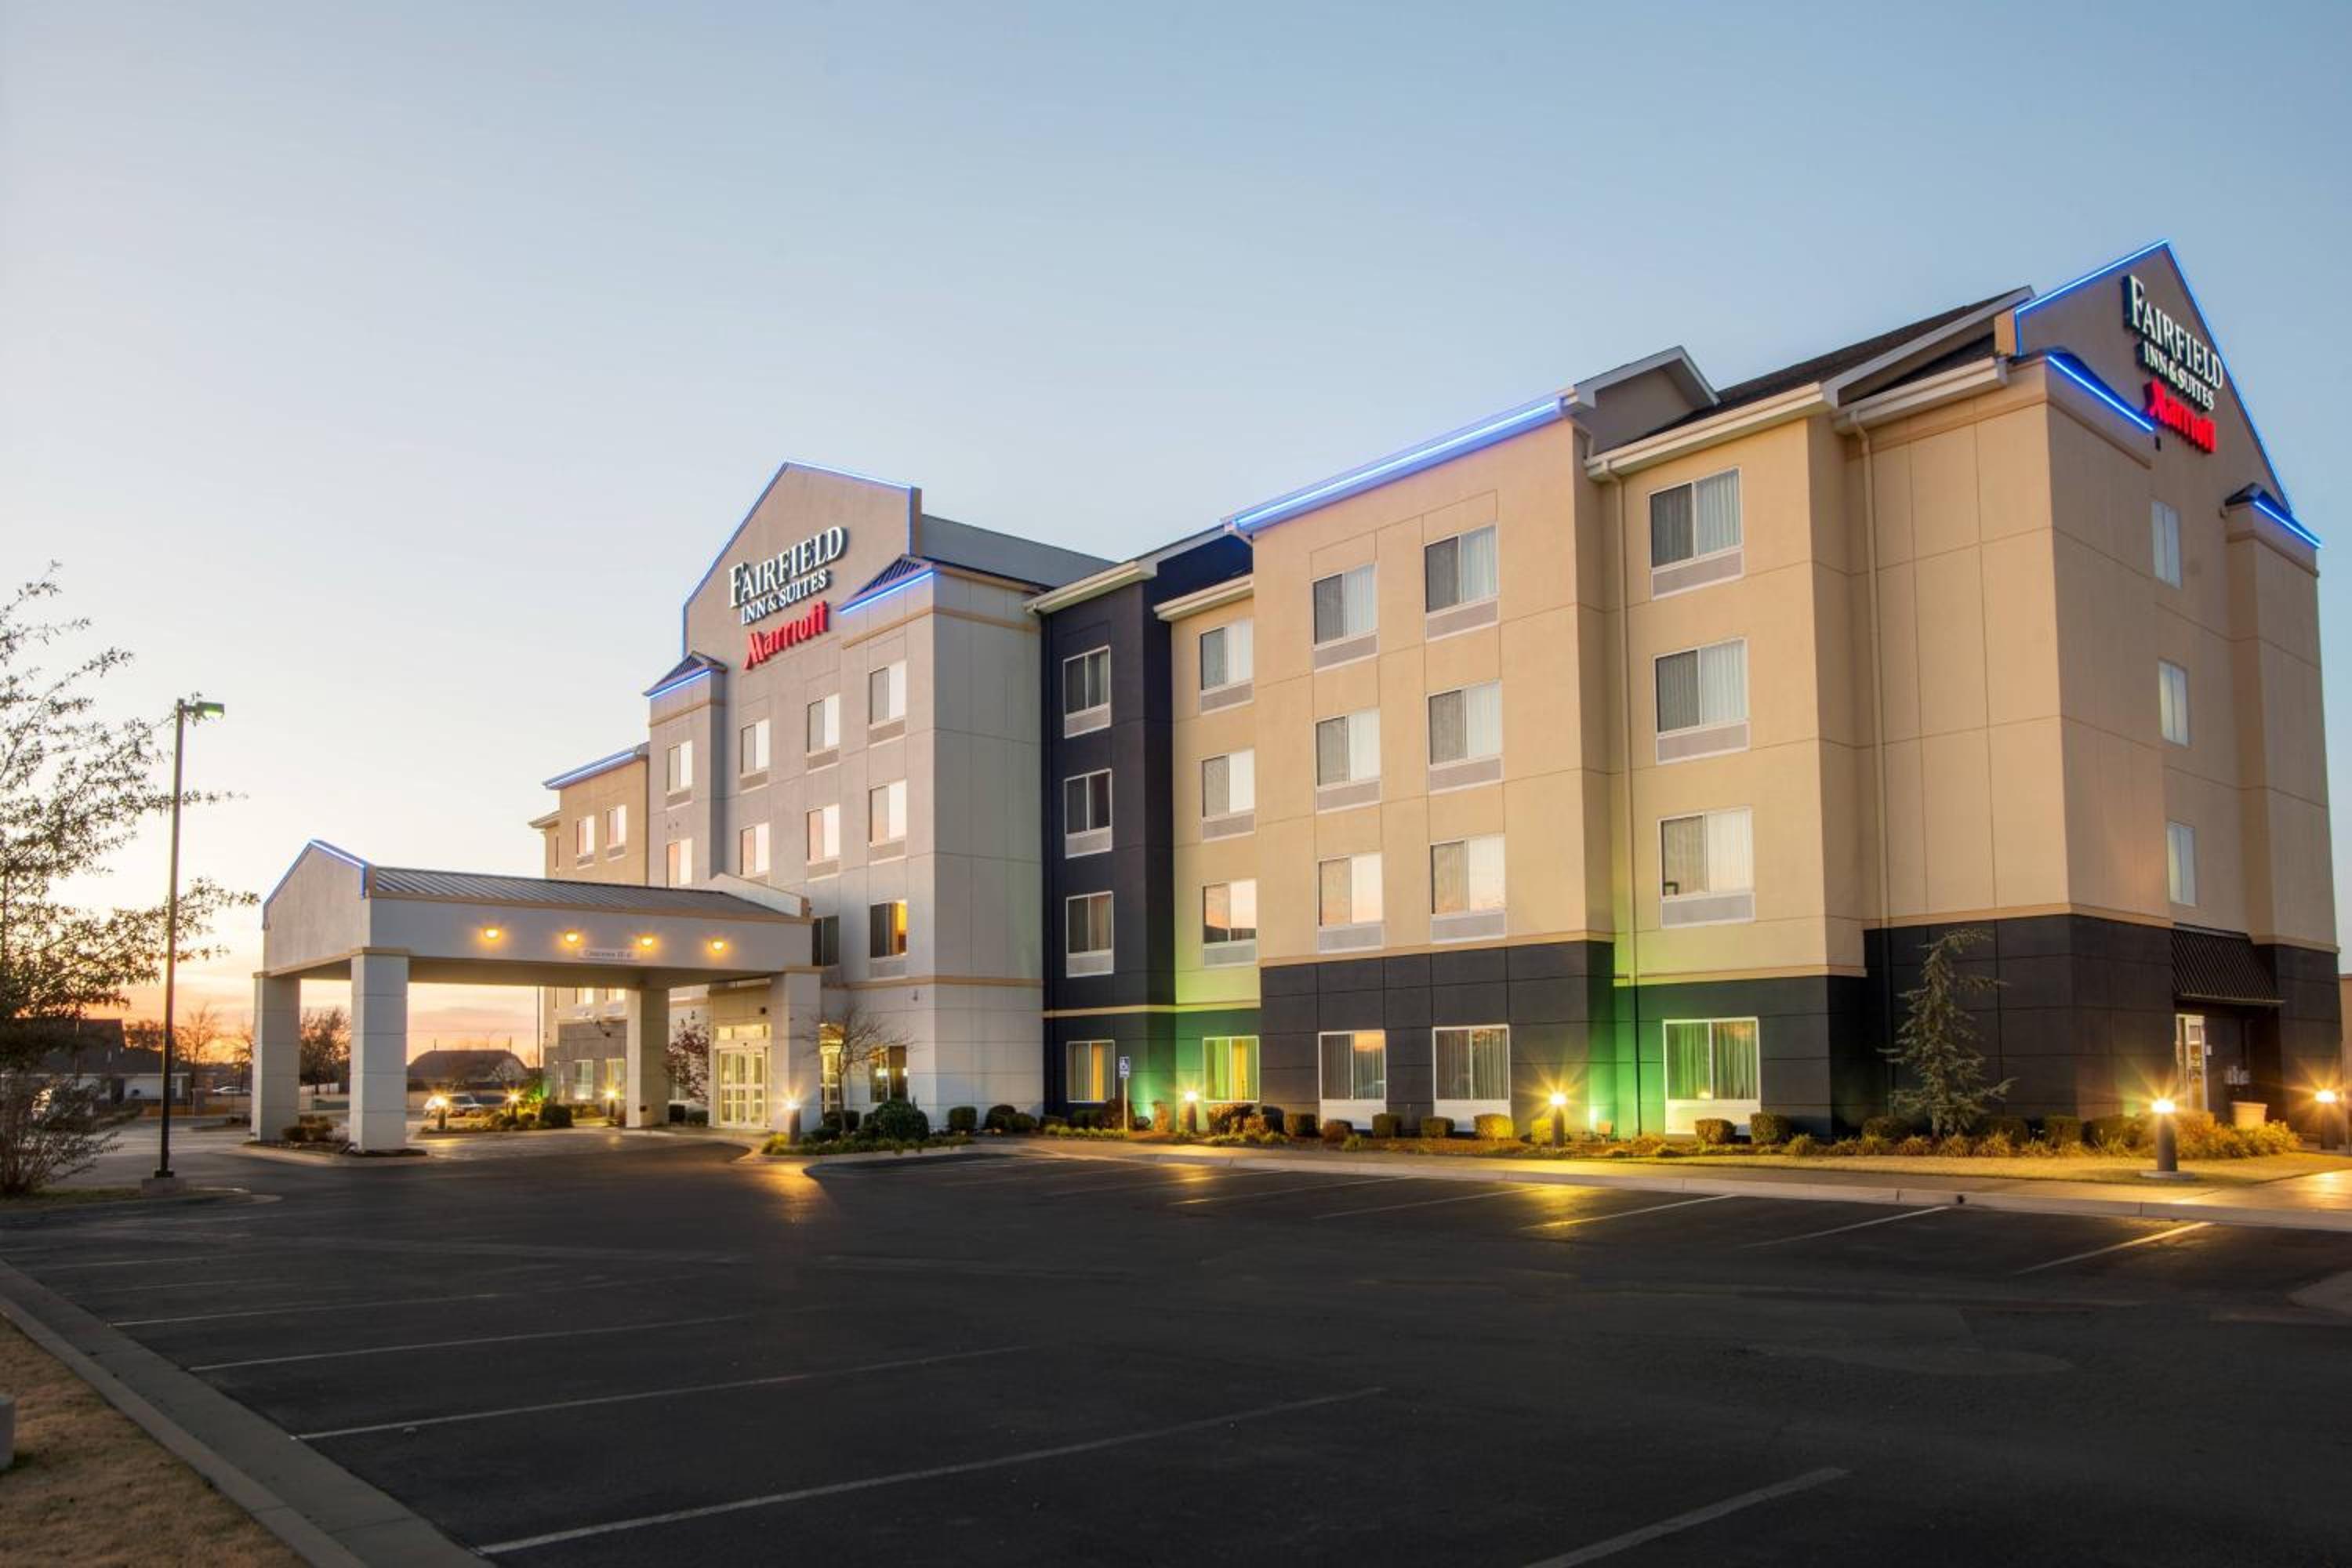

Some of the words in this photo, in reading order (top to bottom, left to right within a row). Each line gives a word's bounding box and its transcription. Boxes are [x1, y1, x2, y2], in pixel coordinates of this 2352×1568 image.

[2129, 274, 2223, 390] FAIRFIELD
[729, 526, 844, 609] FAIRFIELD
[742, 601, 827, 670] Marriott
